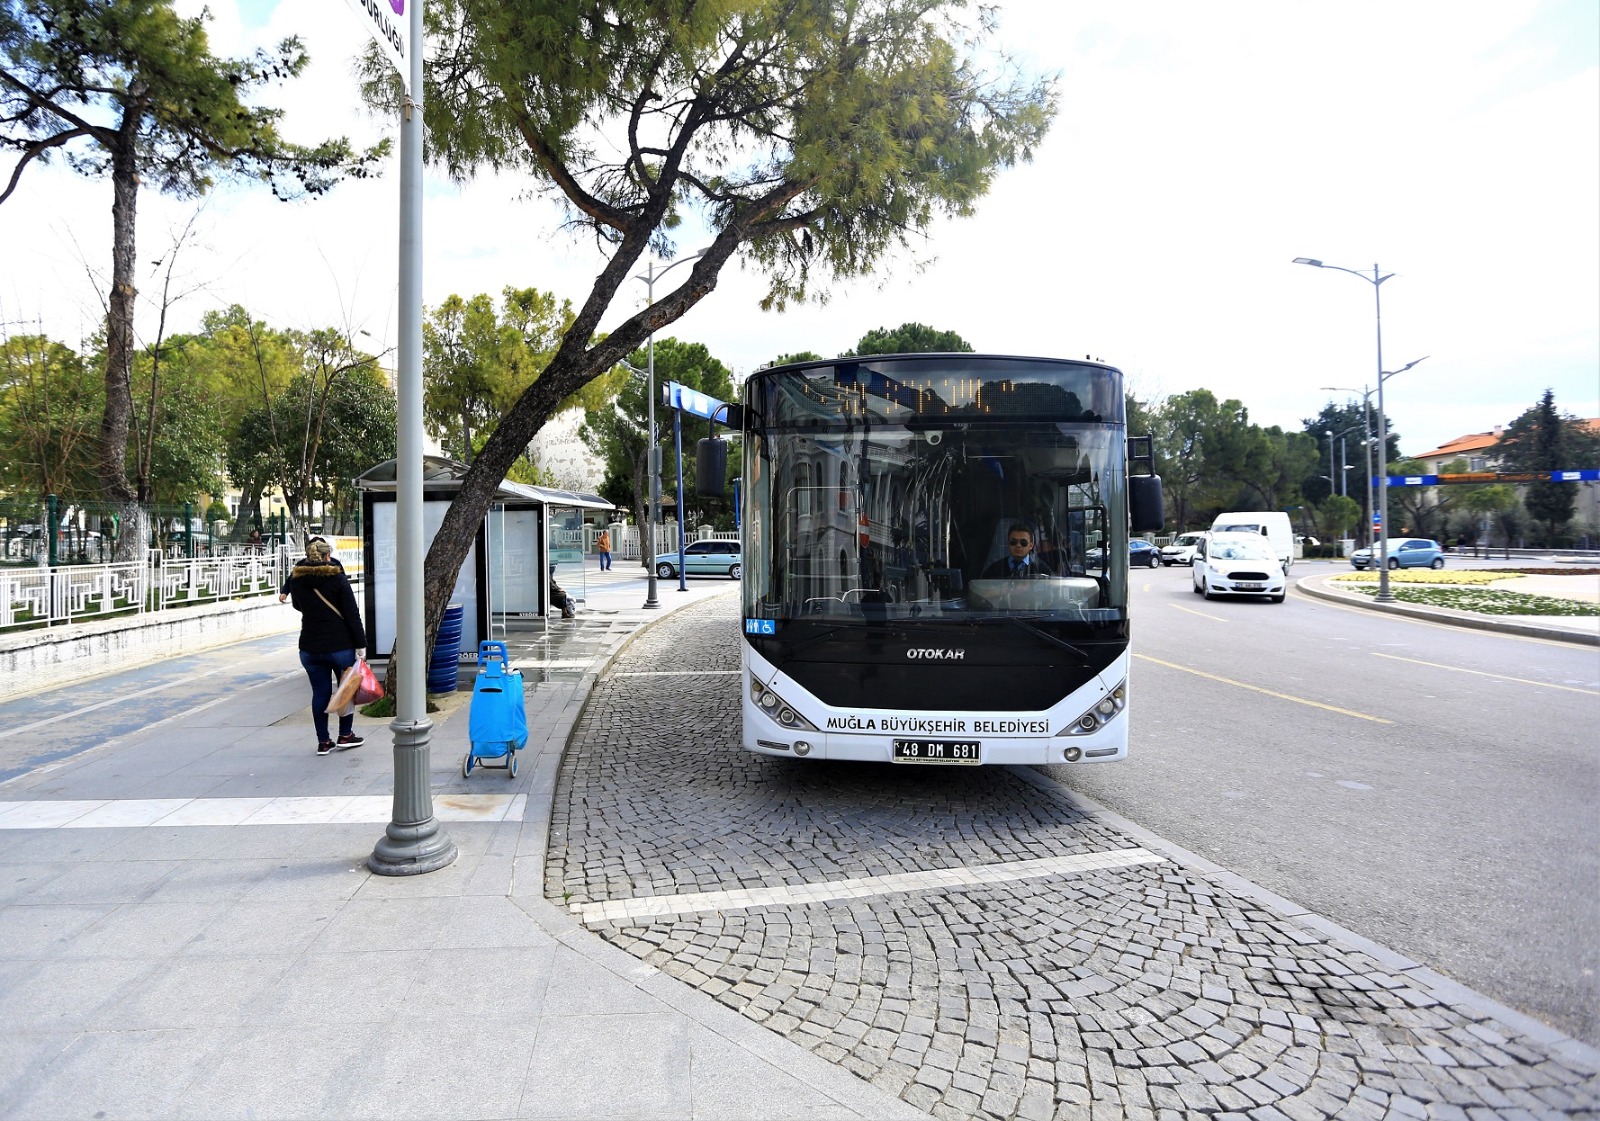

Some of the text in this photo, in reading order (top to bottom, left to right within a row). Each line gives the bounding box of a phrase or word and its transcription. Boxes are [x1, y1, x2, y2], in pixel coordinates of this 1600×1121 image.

[906, 648, 966, 660] OTOKAR
[826, 715, 1049, 735] MUĞLA BÜYÜKŞEHİR BELEDİYESİ
[902, 742, 976, 758] 48 DM 681
